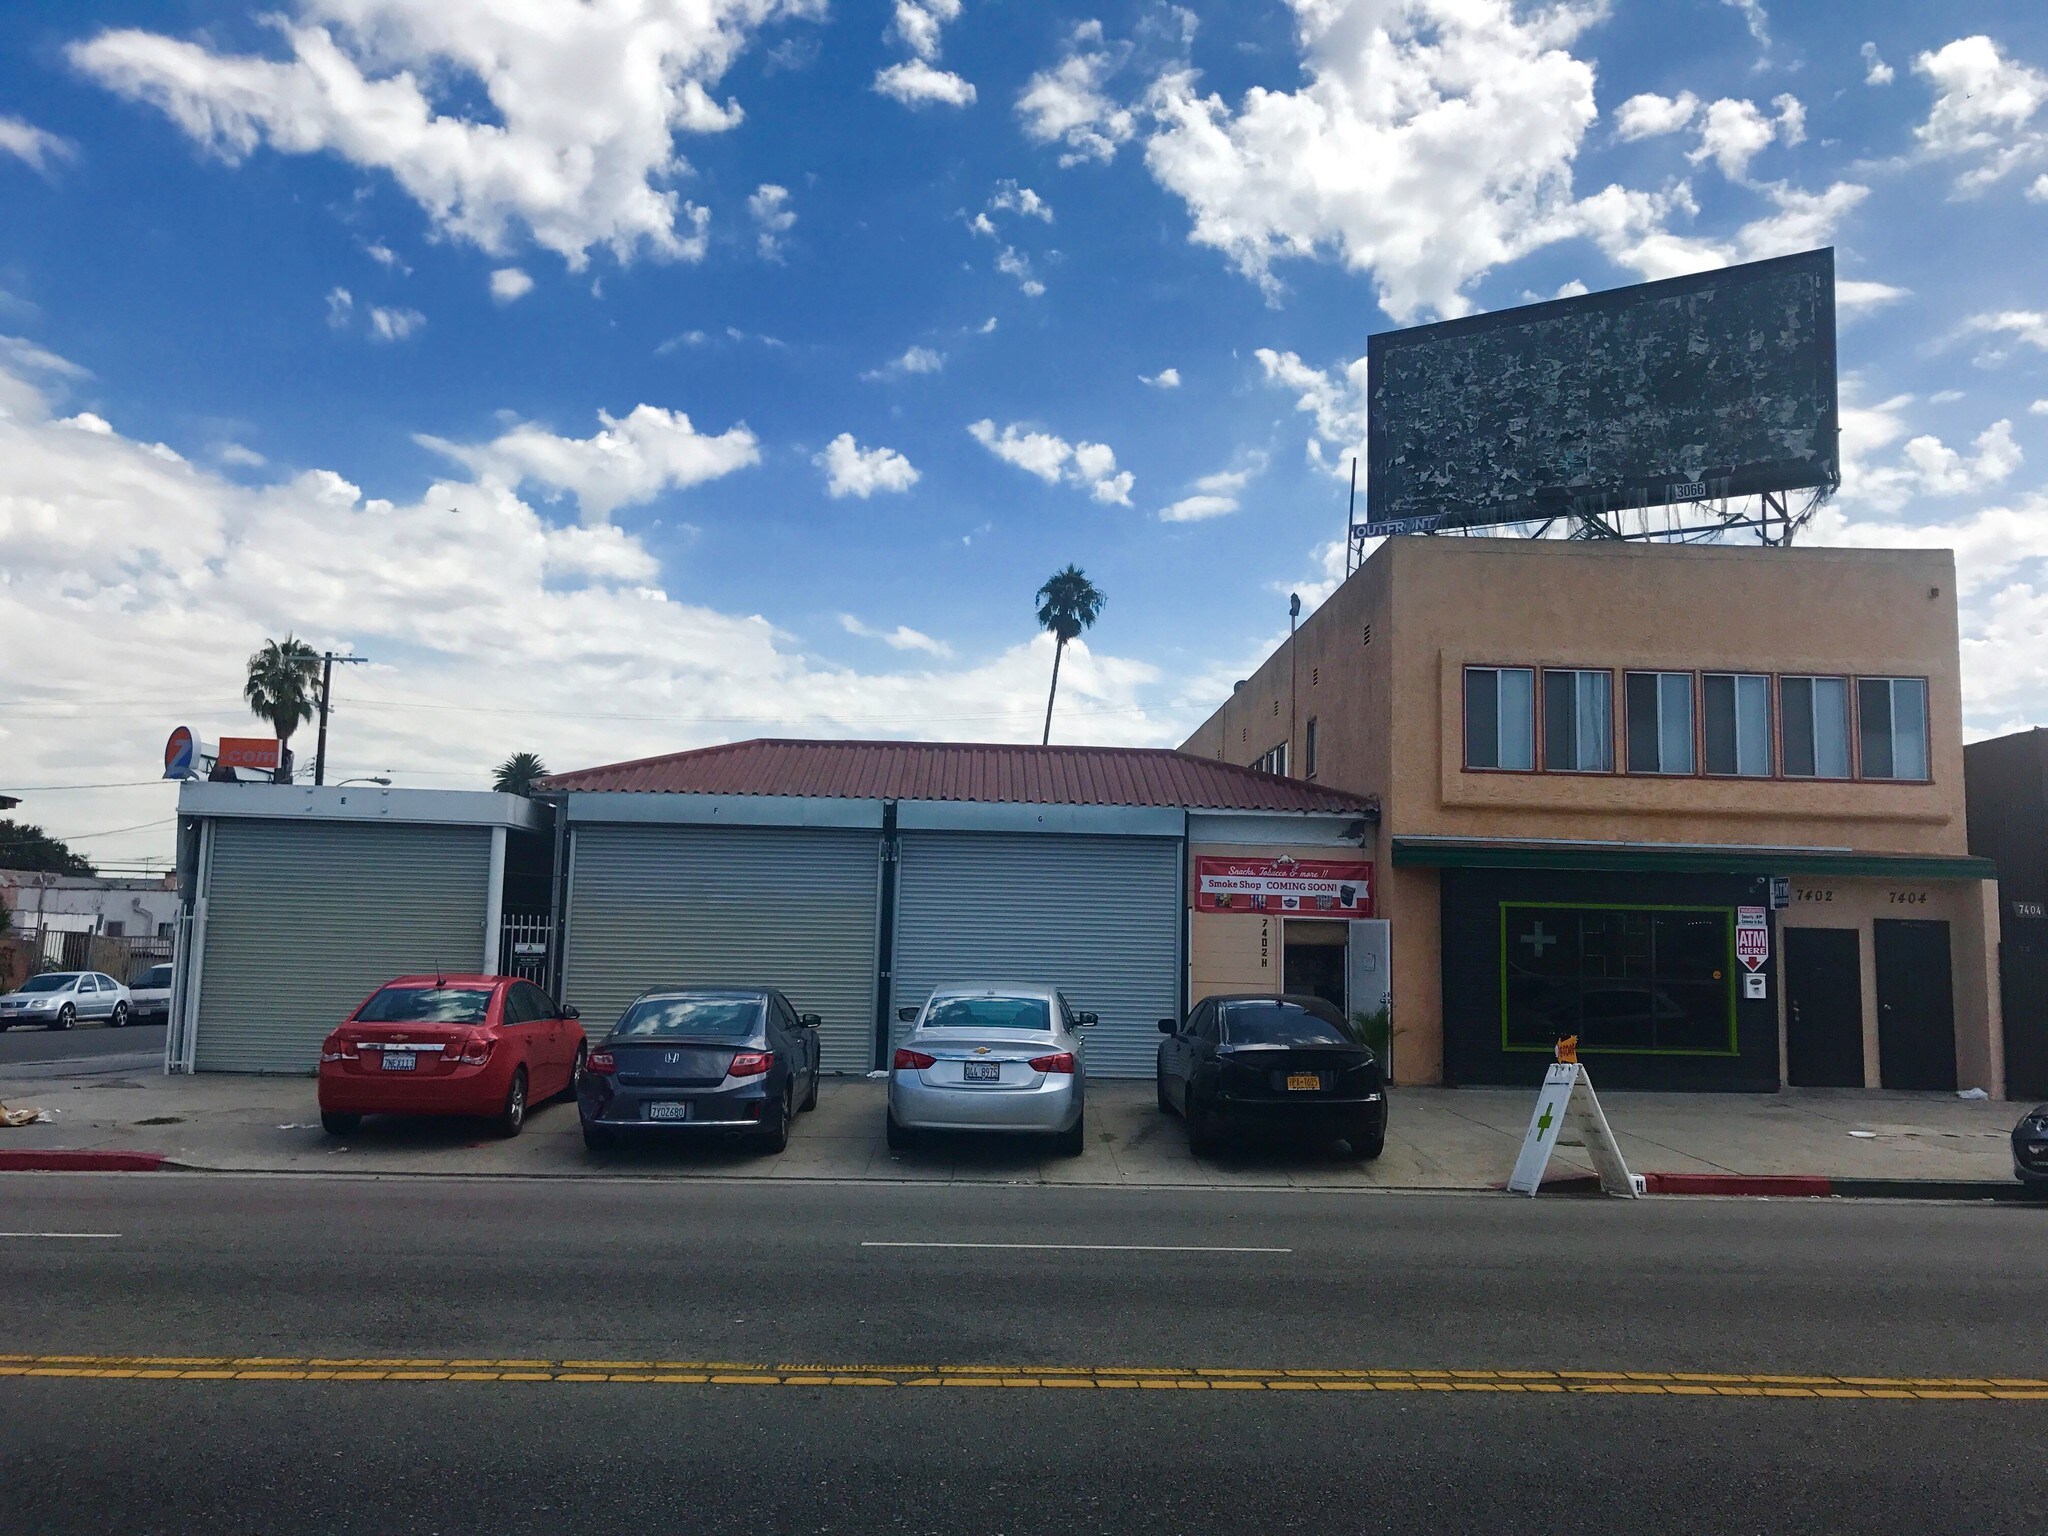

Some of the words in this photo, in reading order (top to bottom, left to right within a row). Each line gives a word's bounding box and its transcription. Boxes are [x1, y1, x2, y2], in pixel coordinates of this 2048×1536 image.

[1677, 484, 1704, 498] 3066
[1356, 517, 1436, 537] OUTFRONT
[340, 797, 347, 805] E
[713, 807, 719, 815] F
[1037, 815, 1043, 823] G
[1259, 866, 1288, 878] Tobacco
[1289, 868, 1298, 878] &
[1208, 879, 1238, 889] Smoke
[1239, 880, 1262, 890] Shop
[1266, 881, 1306, 892] COMING
[1307, 882, 1338, 893] SOON!
[1774, 882, 1789, 897] ATM
[1796, 889, 1833, 902] 7402
[1889, 891, 1927, 904] 7404
[2018, 904, 2042, 916] 7404
[1740, 931, 1766, 947] ATM
[1740, 947, 1766, 955] HERE
[981, 1067, 998, 1078] 8975
[1635, 1180, 1643, 1192] H
